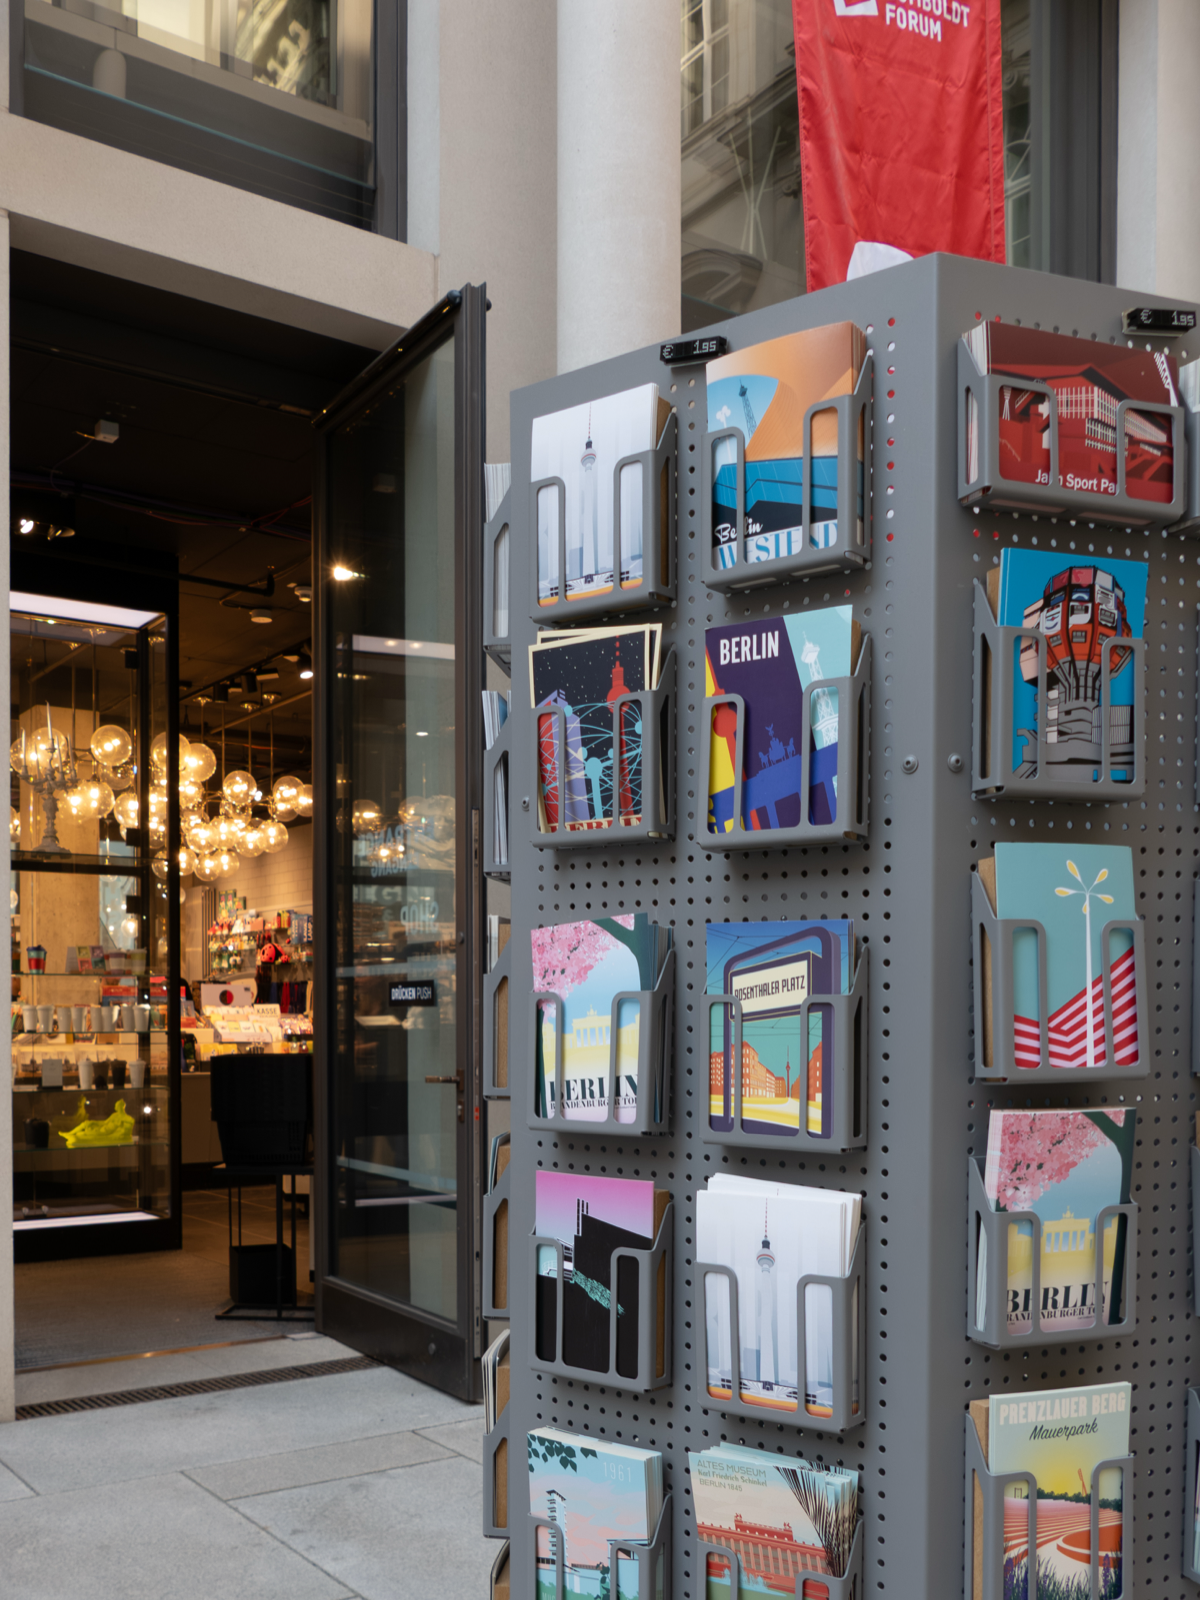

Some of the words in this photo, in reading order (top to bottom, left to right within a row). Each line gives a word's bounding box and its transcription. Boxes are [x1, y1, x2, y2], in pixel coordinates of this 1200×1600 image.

[885, 3, 942, 42] FORUM
[901, 0, 970, 27] BOLDT
[1140, 309, 1152, 324] €
[1171, 310, 1194, 326] 1.95
[662, 345, 674, 359] €
[693, 340, 717, 355] 1.95
[1035, 469, 1063, 486] Jan
[1066, 473, 1098, 491] Sport
[714, 517, 763, 544] Belin
[720, 630, 779, 665] BERLIN
[416, 986, 432, 1000] PUSH
[734, 980, 780, 1002] ROSENTHALER
[781, 975, 806, 993] PLATZ
[257, 1007, 277, 1016] KASSE
[550, 1097, 621, 1110] BANDENBURGR
[1007, 1307, 1085, 1322] RANDNBURGER
[1000, 1396, 1088, 1425] PRENZLAUER
[1092, 1391, 1126, 1416] BERG
[1029, 1417, 1098, 1441] Mauerpark
[603, 1461, 632, 1483] 1961
[697, 1460, 725, 1471] ALTES
[726, 1464, 767, 1478] MUSEUM
[712, 1471, 739, 1482] Friedrich
[740, 1475, 768, 1487] Schinkel
[699, 1478, 726, 1489] BERLIN
[727, 1483, 743, 1492] 1845
